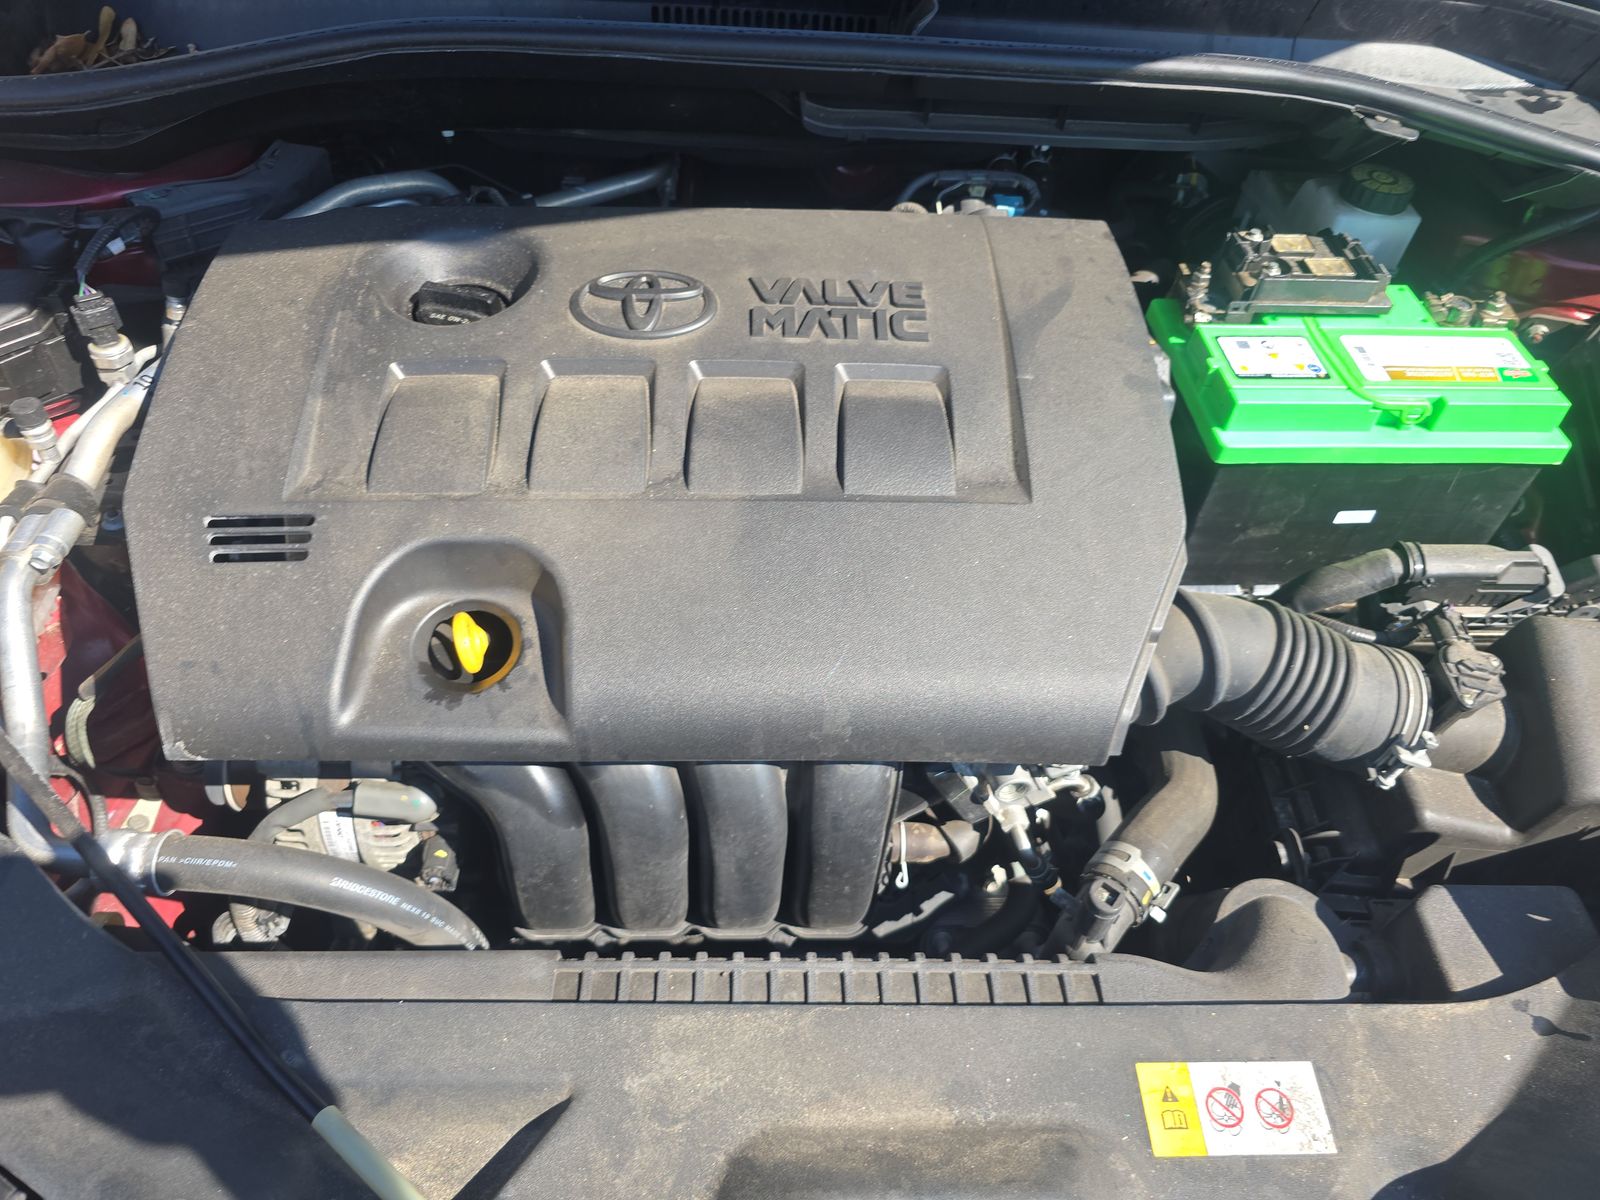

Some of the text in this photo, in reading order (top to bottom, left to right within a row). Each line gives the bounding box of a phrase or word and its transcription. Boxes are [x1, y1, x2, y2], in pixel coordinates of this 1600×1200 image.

[748, 277, 926, 309] VALVE
[749, 306, 930, 343] MATIC
[329, 876, 401, 906] BRIDGESTONE
